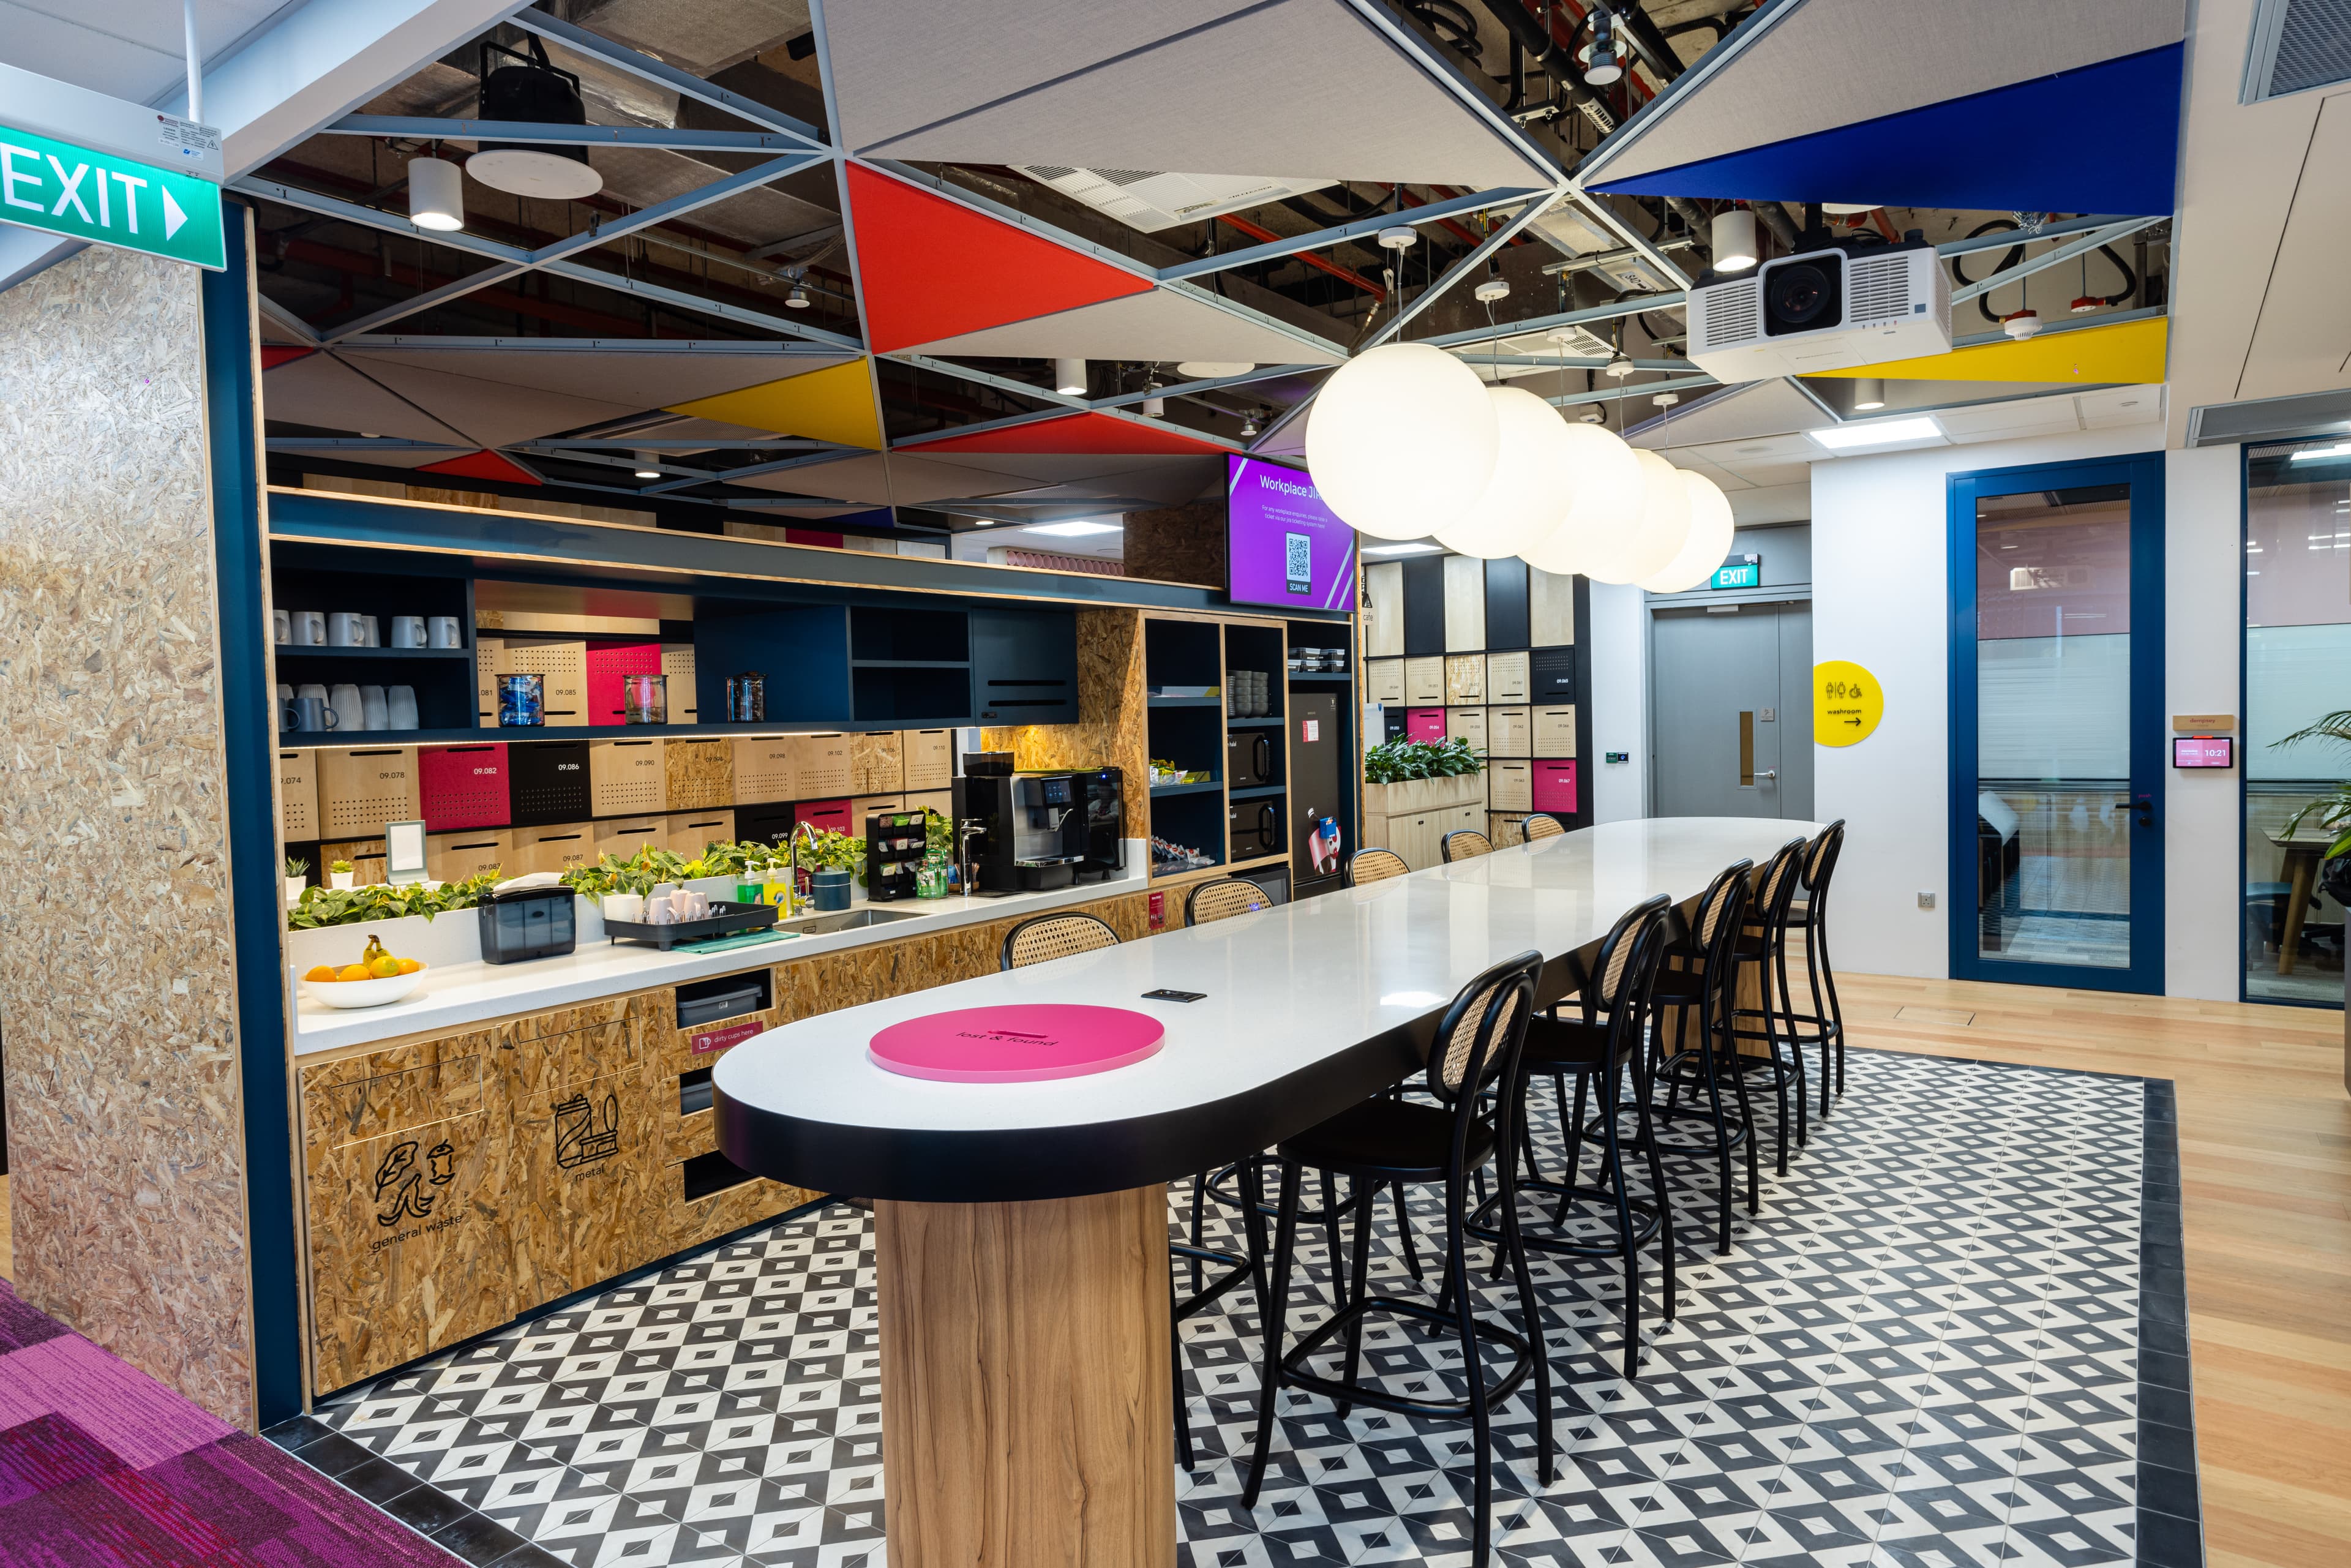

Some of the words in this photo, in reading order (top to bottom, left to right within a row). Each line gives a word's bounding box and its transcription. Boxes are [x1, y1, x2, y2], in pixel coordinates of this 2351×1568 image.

[0, 142, 148, 234] EXIT
[1260, 475, 1307, 497] Workplace
[1308, 486, 1323, 500] JIR
[1292, 518, 1307, 527] ticketing
[1720, 568, 1749, 585] EXIT
[1289, 583, 1302, 591] SCAN
[1302, 583, 1308, 593] ME
[1363, 612, 1373, 621] cafe
[563, 853, 583, 862] 09.087
[478, 863, 501, 872] 09.083
[1007, 1037, 1059, 1046] found
[576, 1163, 604, 1181] metal
[372, 1224, 421, 1253] general
[426, 1215, 463, 1232] waste
